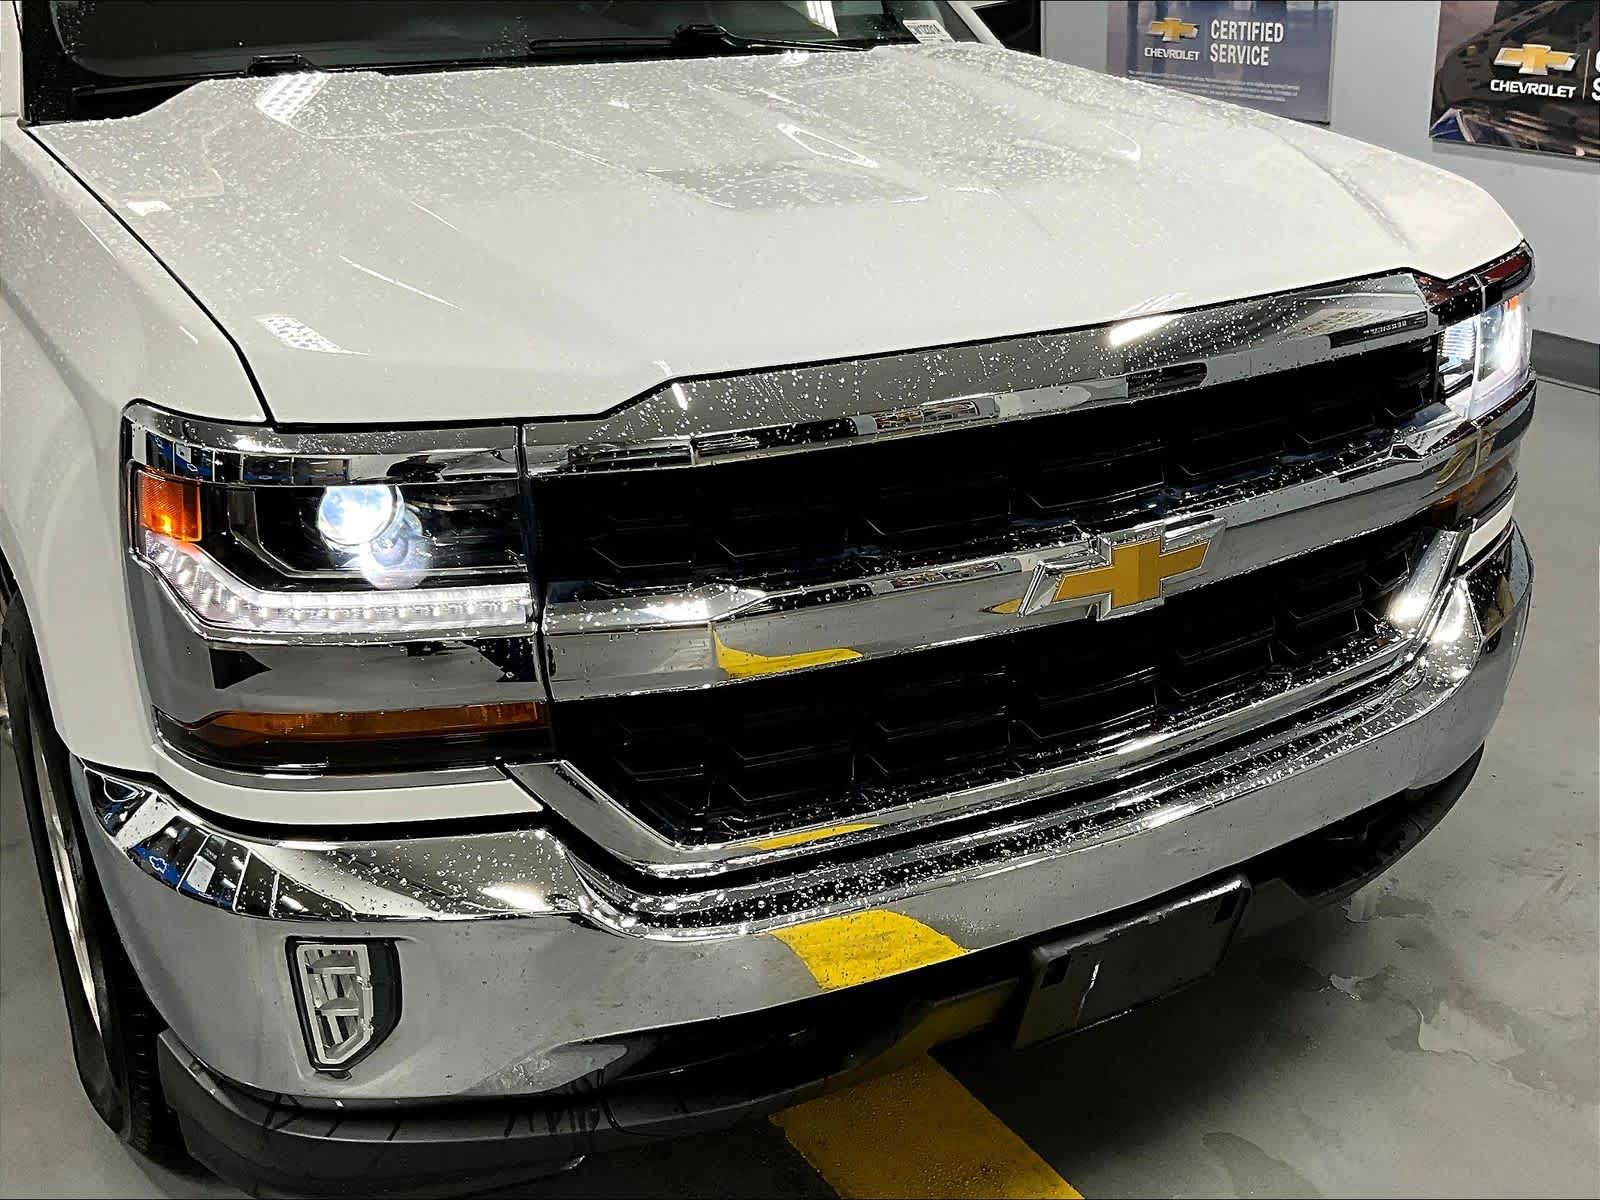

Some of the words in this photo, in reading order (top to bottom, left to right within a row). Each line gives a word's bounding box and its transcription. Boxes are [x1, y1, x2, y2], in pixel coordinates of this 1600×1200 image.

[1211, 19, 1284, 43] CERTIFIED
[1144, 47, 1200, 61] CHEVROLET
[1210, 43, 1270, 66] SERVICE
[1490, 79, 1577, 99] CHEVROLET
